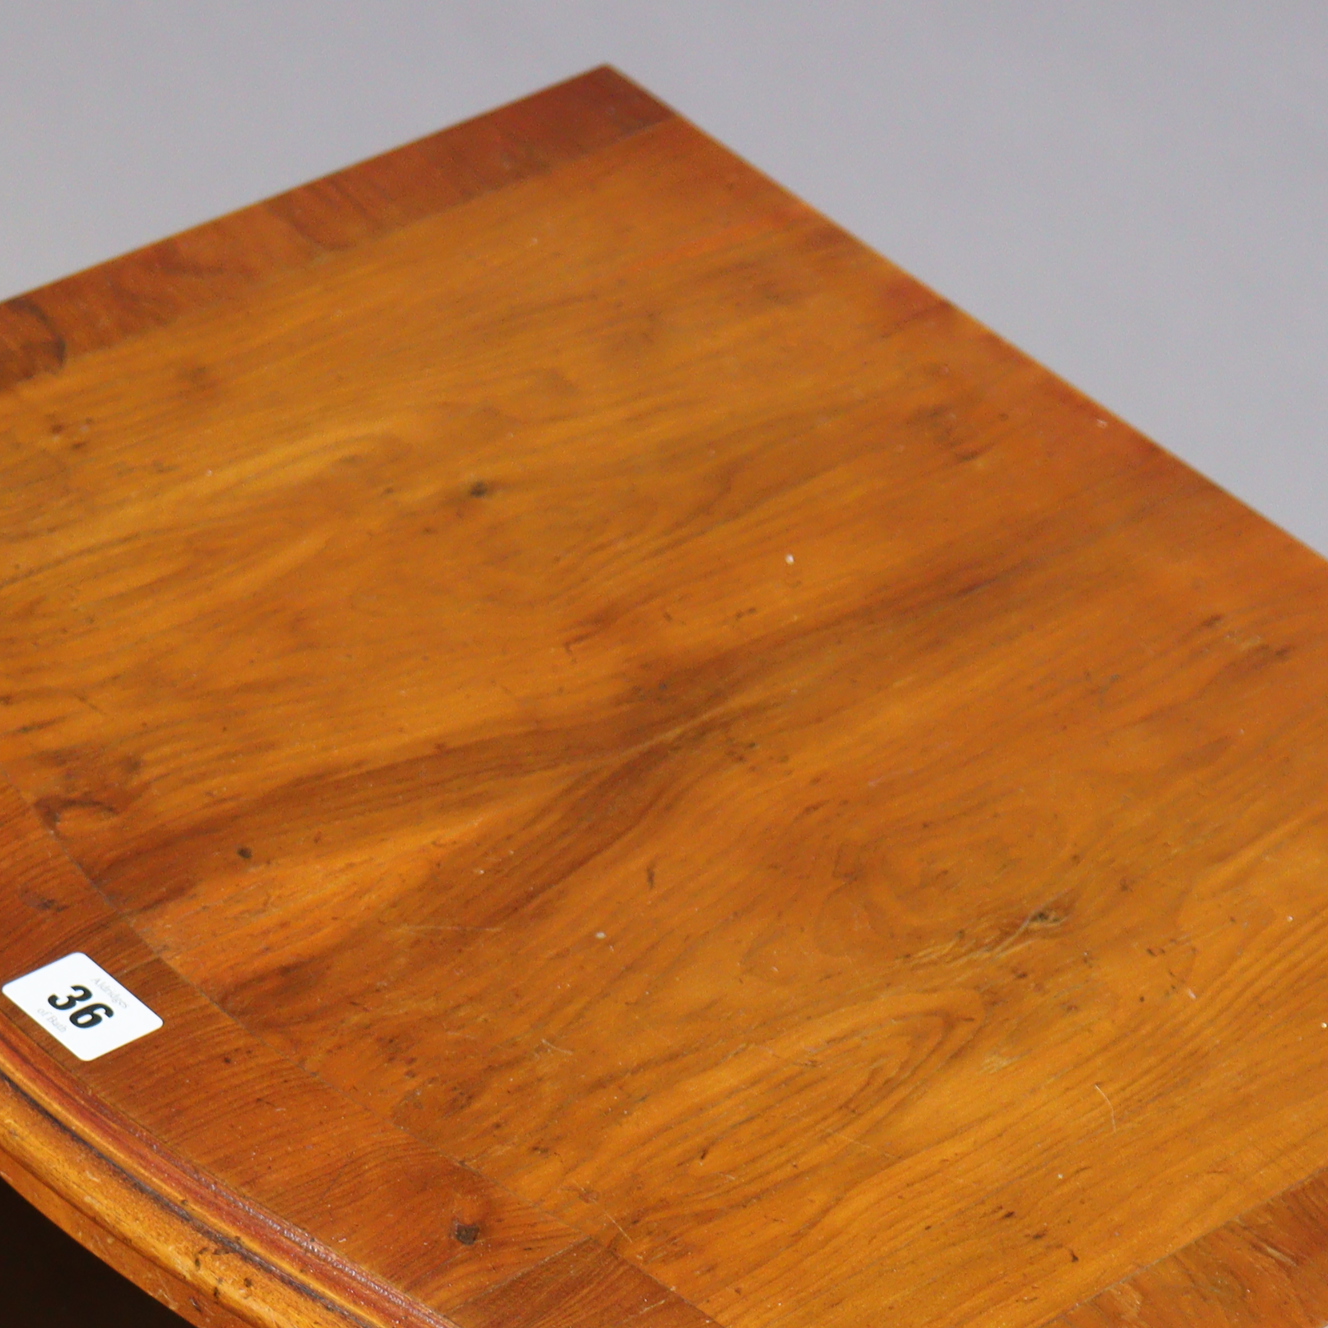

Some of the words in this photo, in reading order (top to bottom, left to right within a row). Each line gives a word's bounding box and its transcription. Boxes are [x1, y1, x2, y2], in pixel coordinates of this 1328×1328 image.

[37, 1007, 52, 1017] of
[46, 1014, 67, 1033] Bath
[47, 985, 114, 1029] 36
